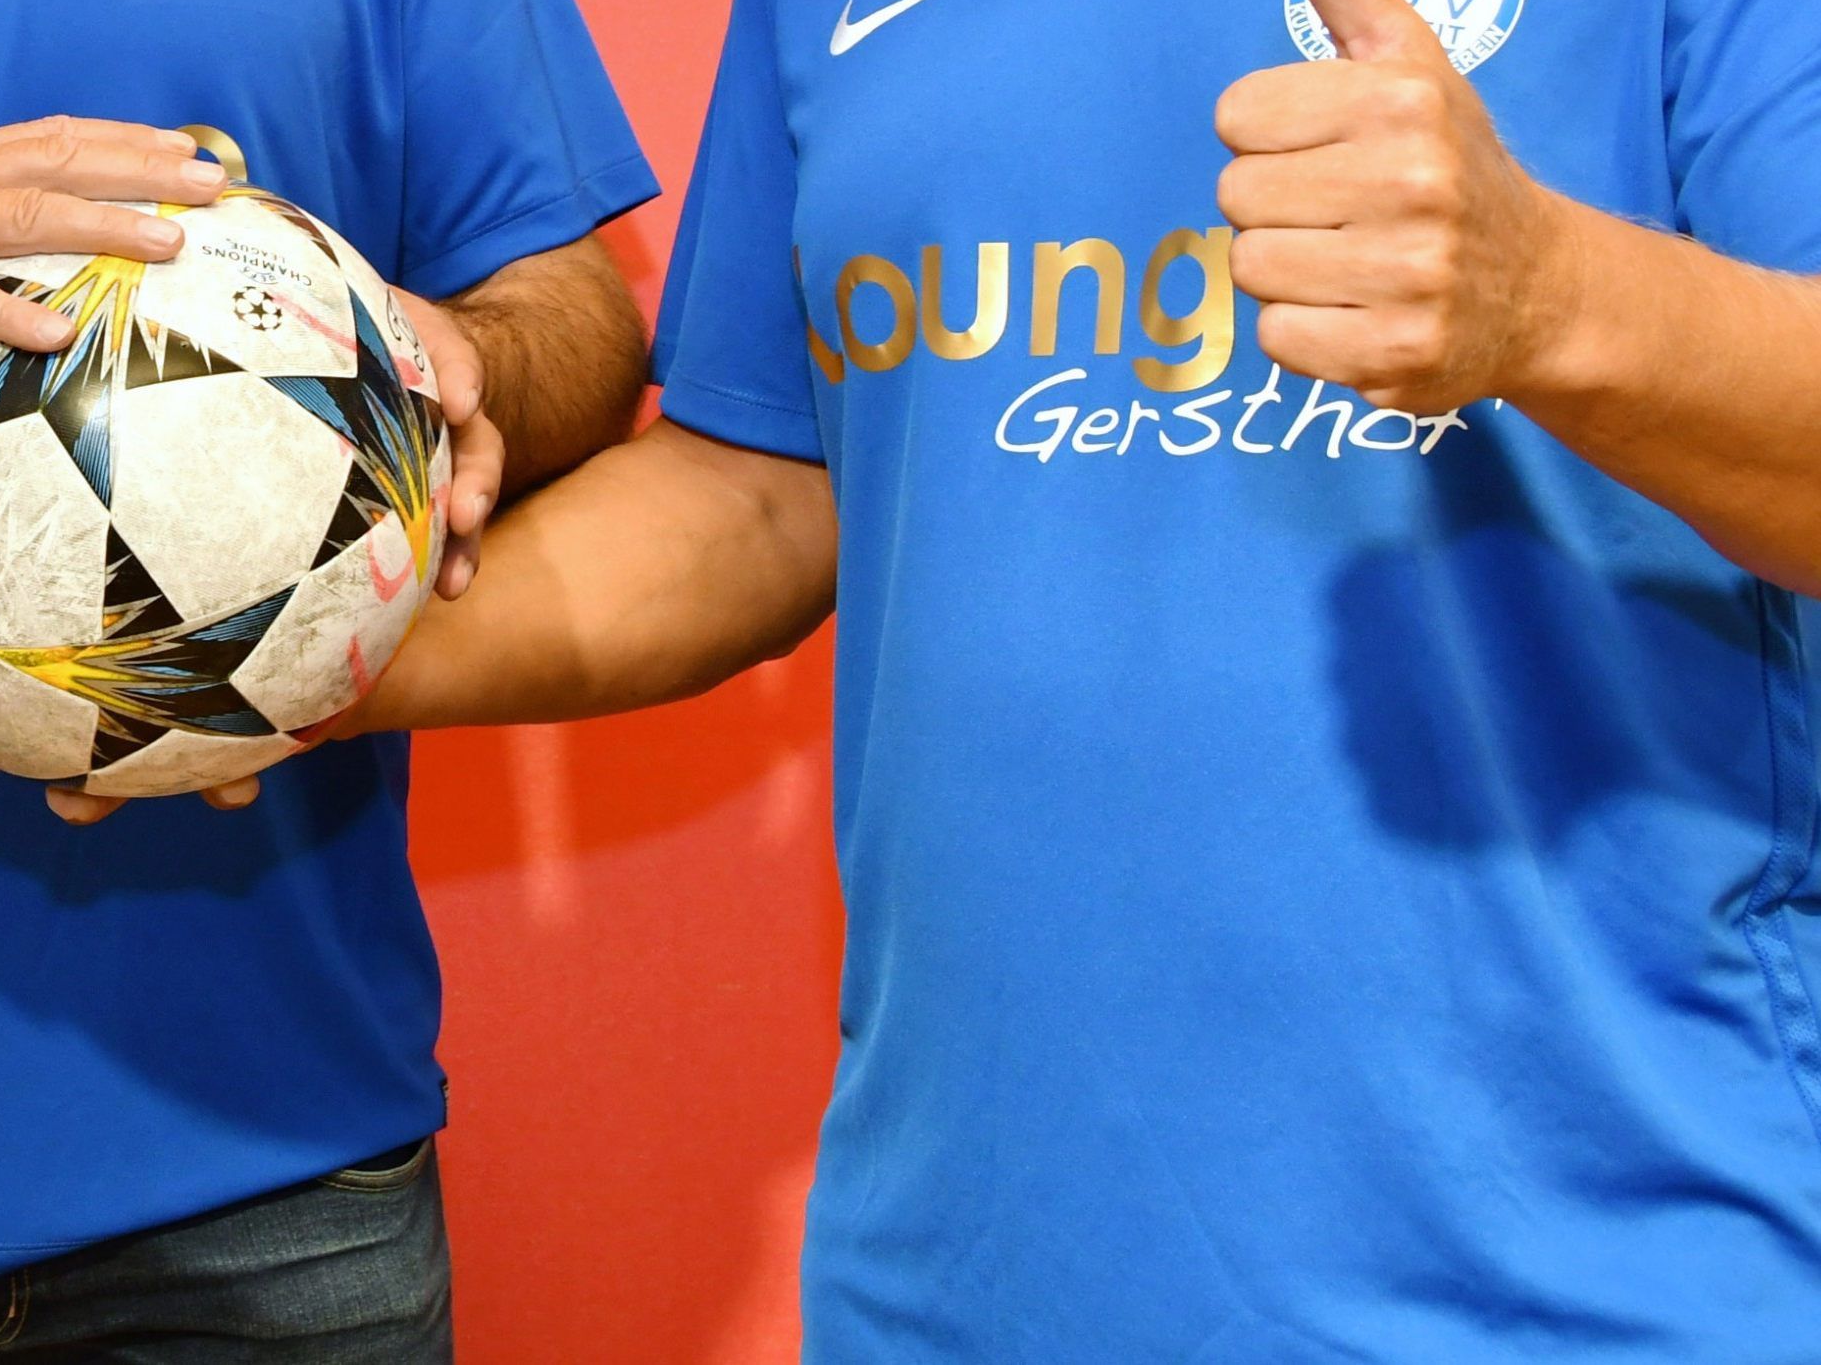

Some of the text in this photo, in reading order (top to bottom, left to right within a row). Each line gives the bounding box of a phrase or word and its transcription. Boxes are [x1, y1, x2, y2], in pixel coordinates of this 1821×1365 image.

[1445, 23, 1506, 71] EREIN
[200, 243, 313, 288] CHAMPIONS
[791, 225, 1235, 392] Loung
